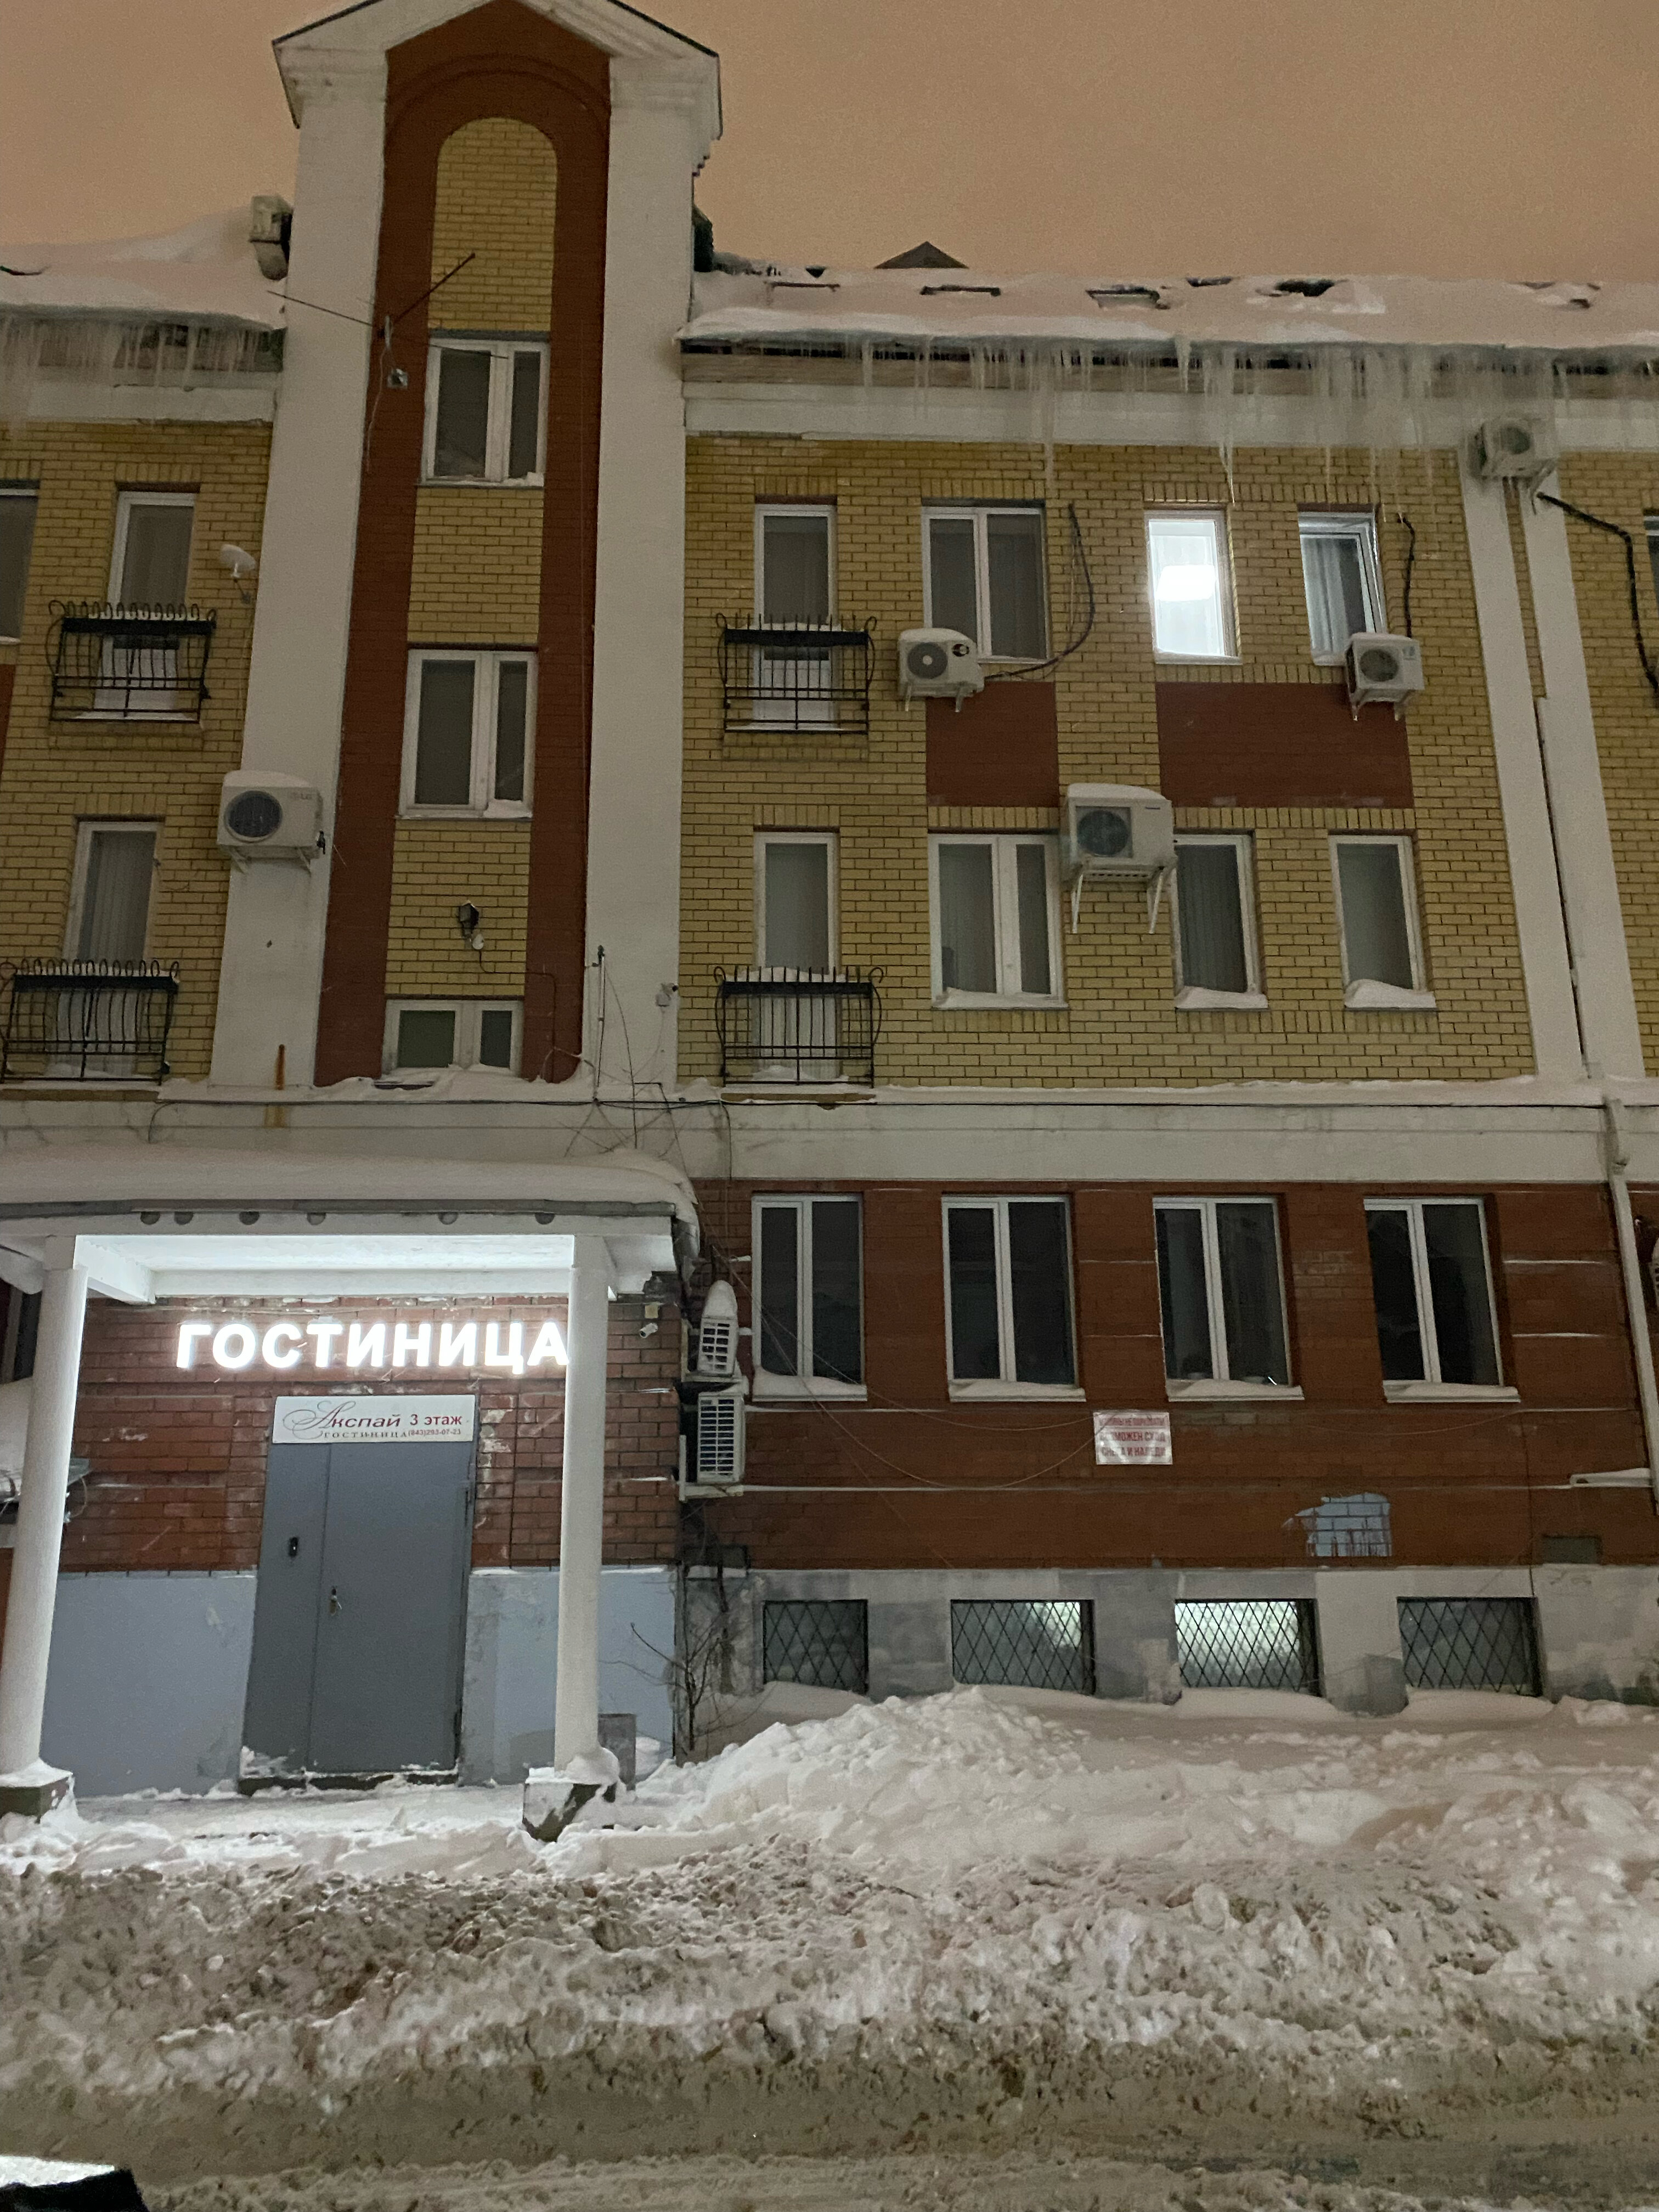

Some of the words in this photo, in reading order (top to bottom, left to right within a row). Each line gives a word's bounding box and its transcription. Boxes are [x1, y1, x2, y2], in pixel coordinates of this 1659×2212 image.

[176, 1322, 569, 1374] ГОСТИНИЦА
[283, 1401, 401, 1439] Акспай
[410, 1414, 418, 1425] 3
[424, 1416, 462, 1425] этаж
[1099, 1432, 1143, 1441] ВЗМОЖЕН
[1101, 1447, 1125, 1456] СНЕА
